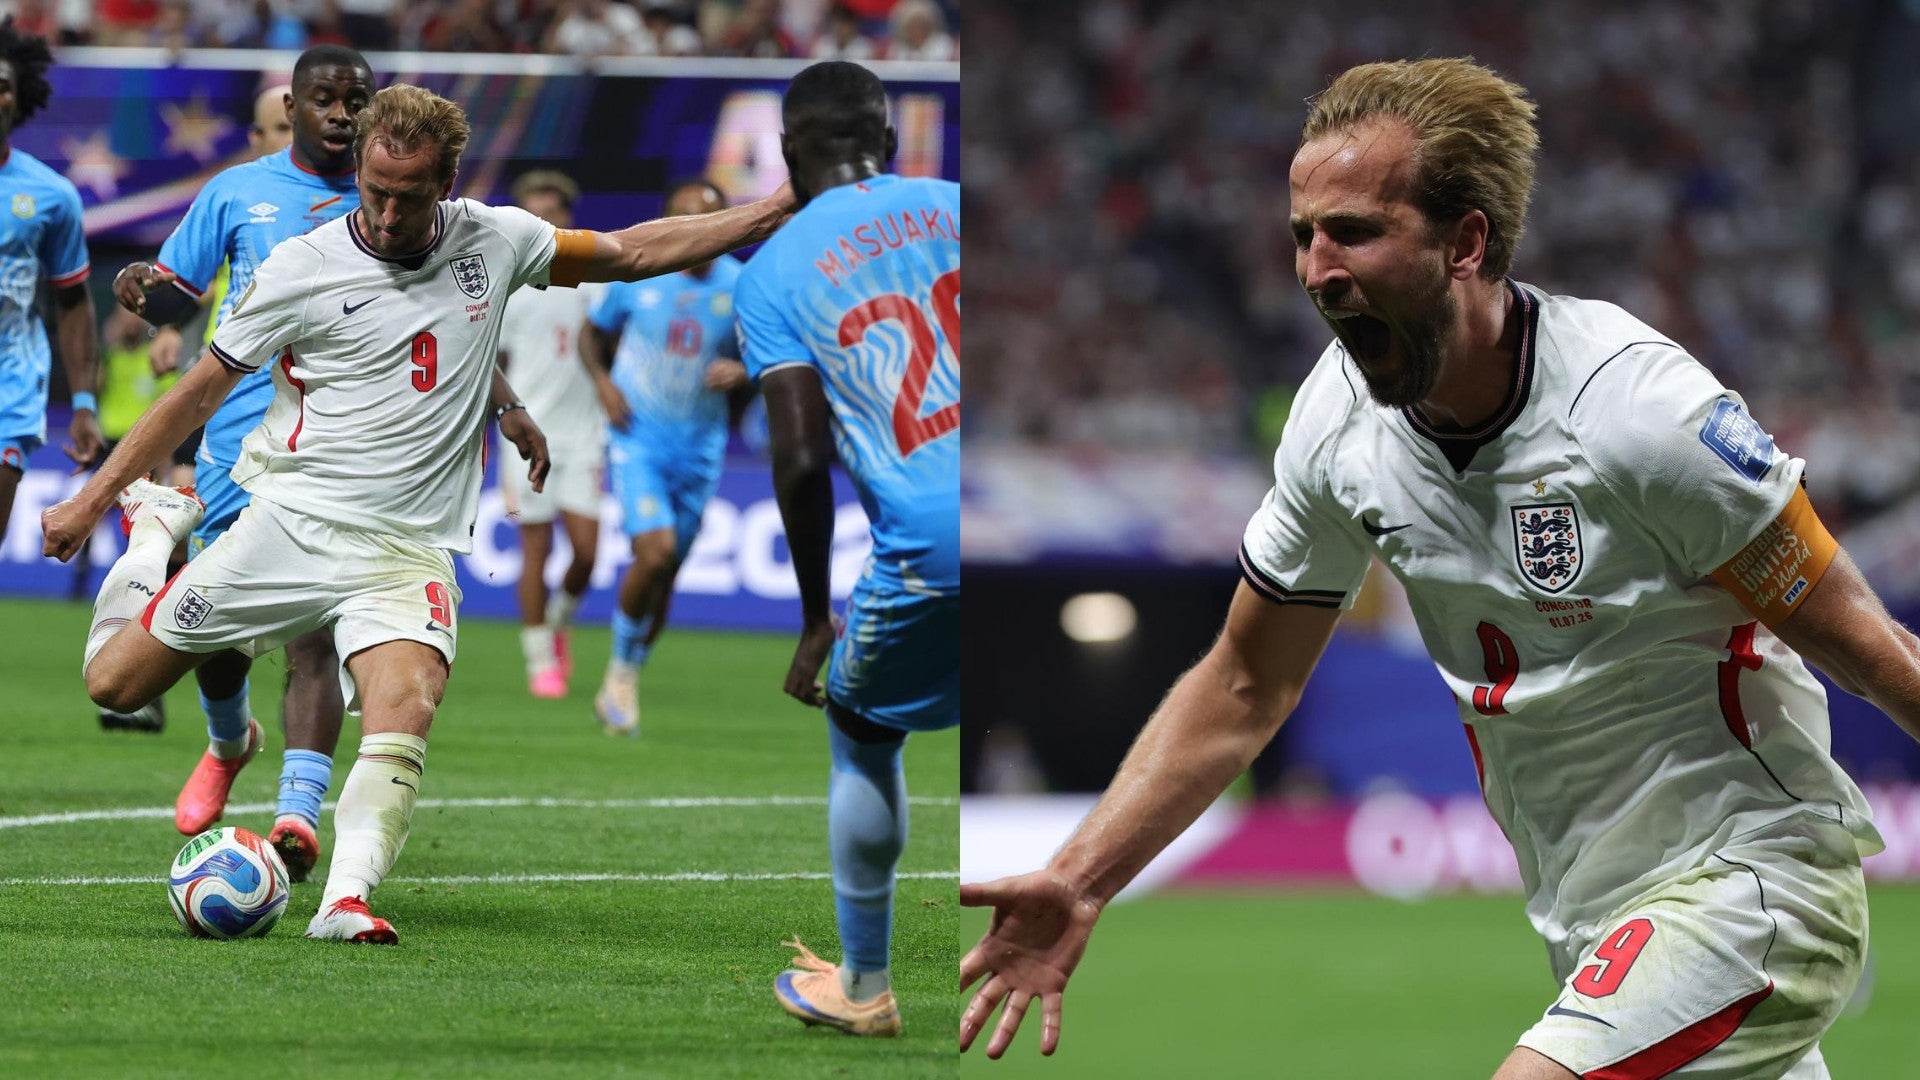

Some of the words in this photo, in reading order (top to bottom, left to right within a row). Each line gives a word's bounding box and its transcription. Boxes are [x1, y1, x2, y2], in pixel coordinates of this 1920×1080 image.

[411, 331, 437, 392] 9
[1723, 415, 1749, 453] UNITES
[1729, 519, 1788, 580] FOOTBALL
[1740, 527, 1799, 593] UNITES
[1755, 587, 1777, 609] the
[1773, 539, 1812, 590] World
[425, 581, 451, 628] 9
[1535, 600, 1575, 613] CONGO
[1575, 598, 1594, 610] DR
[1548, 611, 1594, 629] 01.07.26
[1783, 578, 1808, 604] FIFA
[1472, 620, 1520, 716] 9
[1571, 918, 1655, 999] 9
